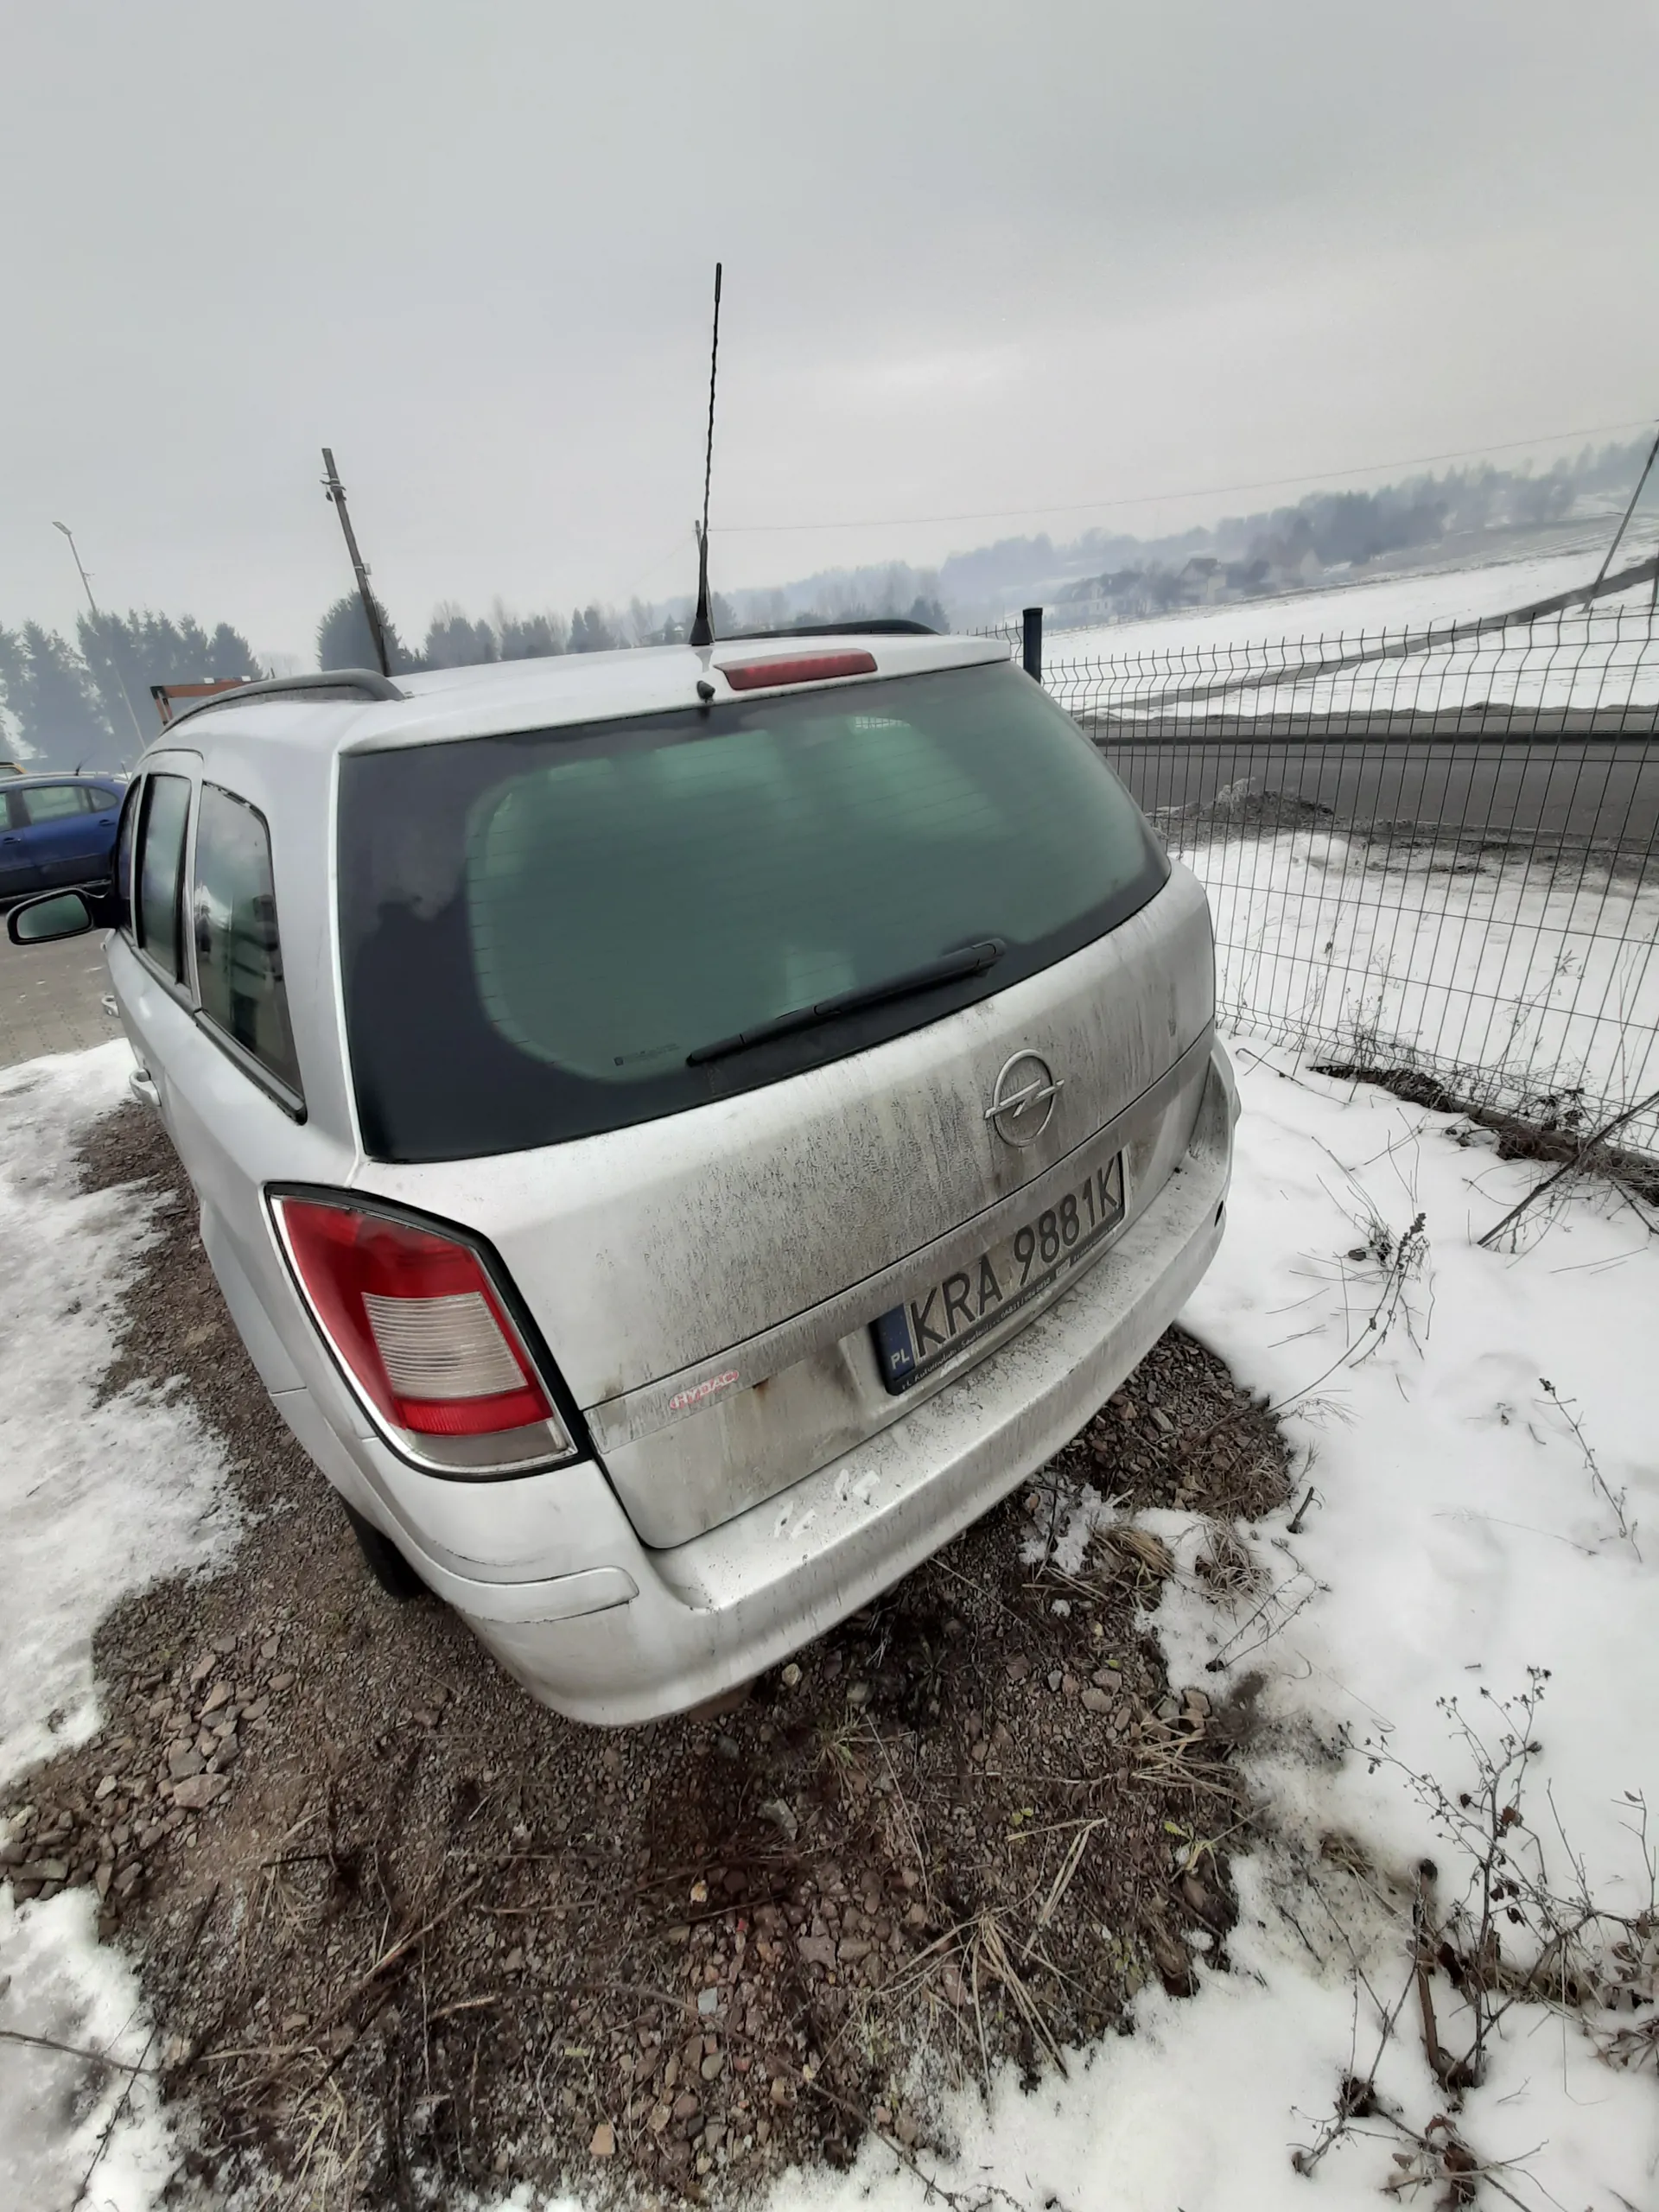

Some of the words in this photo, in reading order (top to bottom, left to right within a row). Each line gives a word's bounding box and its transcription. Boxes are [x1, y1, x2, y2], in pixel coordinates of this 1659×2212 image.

[910, 1253, 1003, 1358] KRA
[1014, 1158, 1119, 1287] 9881K
[890, 1348, 910, 1370] PL
